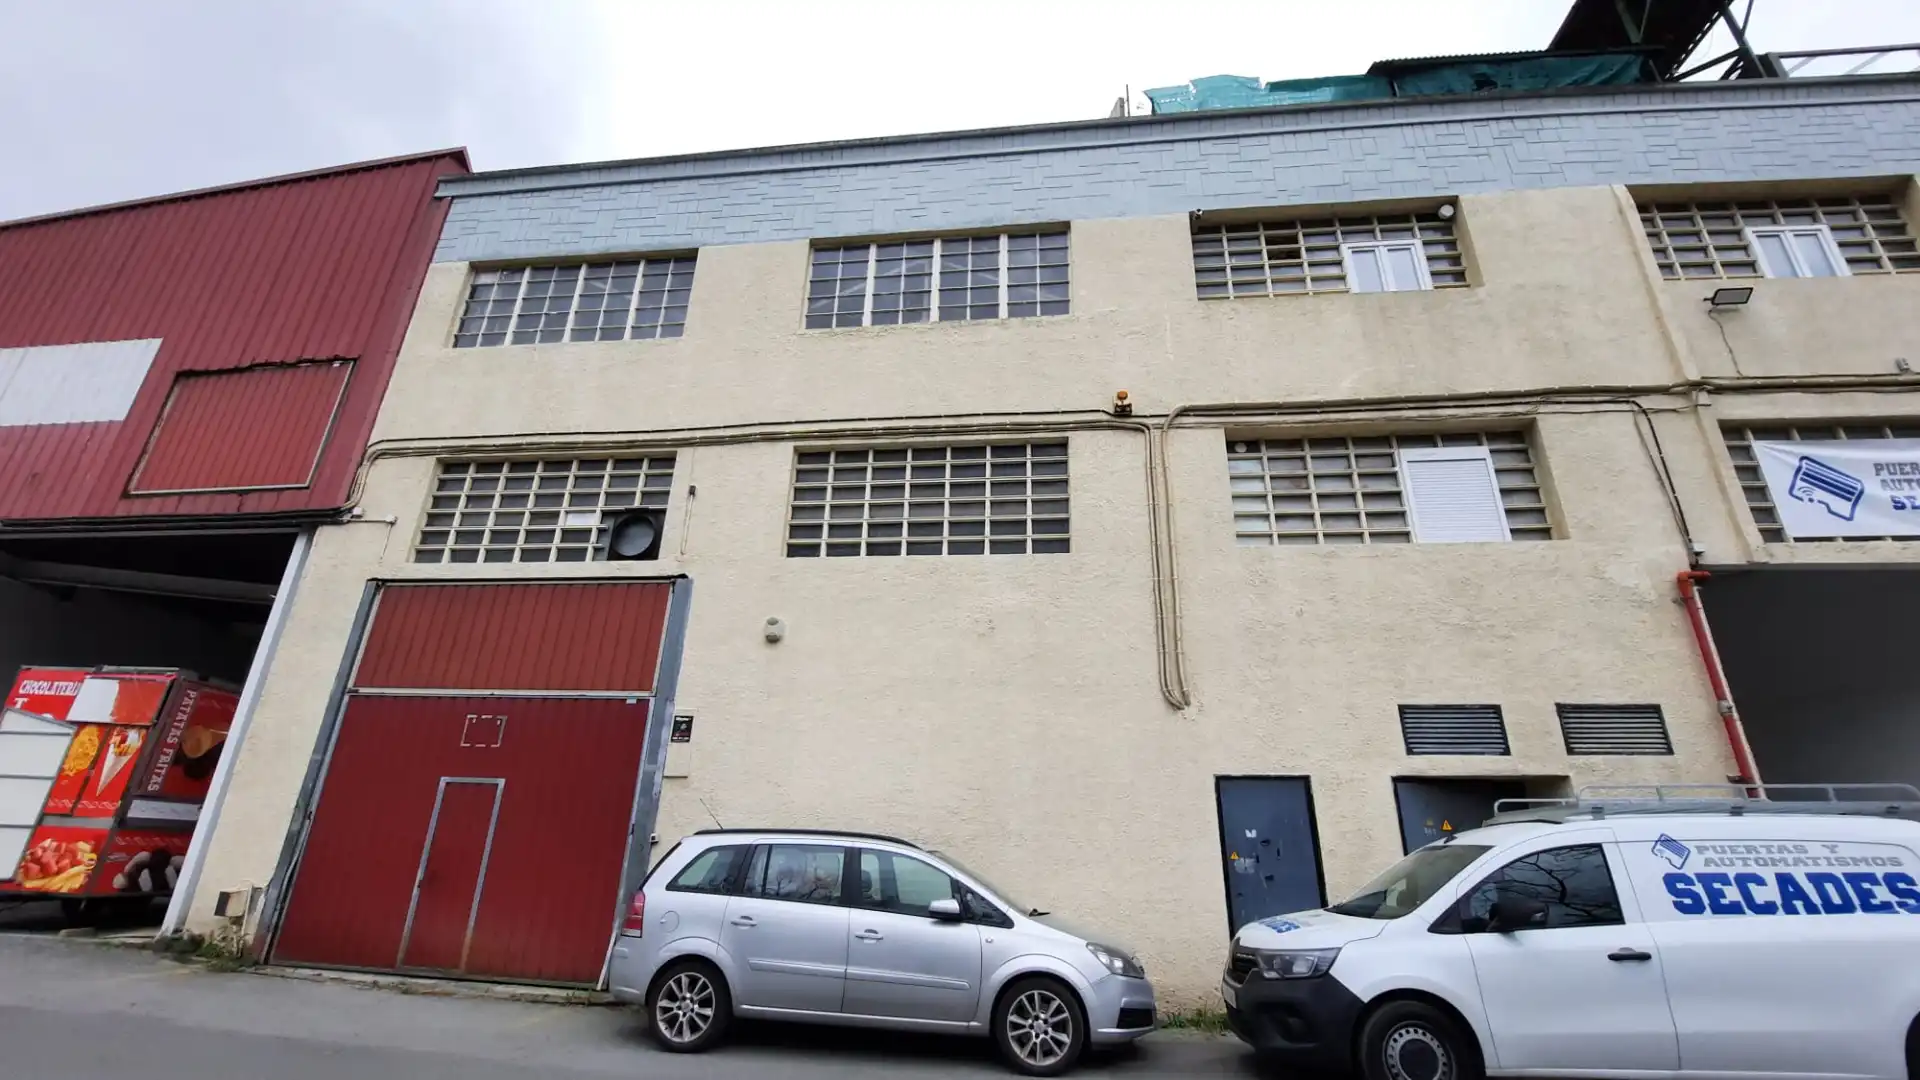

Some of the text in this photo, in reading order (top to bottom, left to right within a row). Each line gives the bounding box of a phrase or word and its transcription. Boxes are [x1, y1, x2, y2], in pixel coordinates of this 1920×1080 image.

[147, 689, 197, 792] PATATAS FRITAS
[1694, 844, 1839, 855] PUERTAS Y
[1703, 856, 1904, 868] AUTOMATISMOS
[1662, 872, 1920, 915] SECADES
